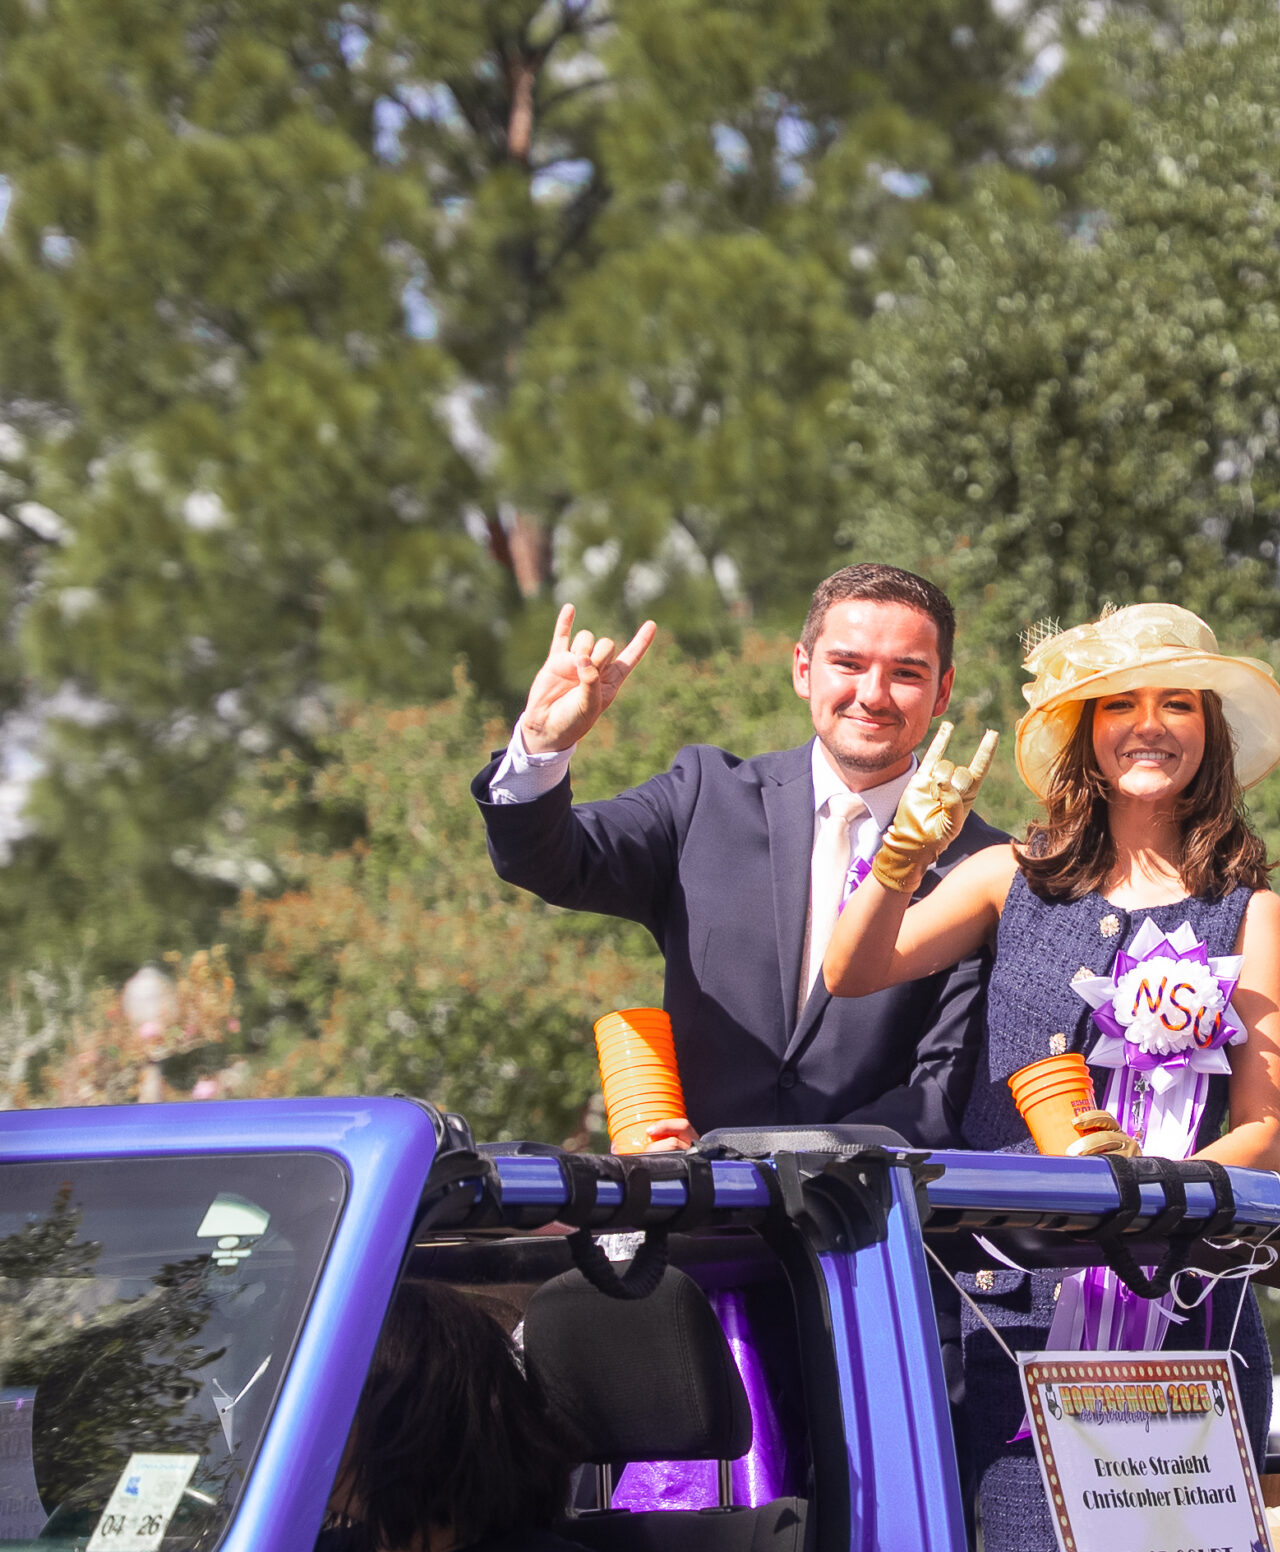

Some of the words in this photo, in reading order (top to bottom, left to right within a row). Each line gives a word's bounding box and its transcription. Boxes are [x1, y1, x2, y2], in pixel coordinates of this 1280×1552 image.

[1131, 975, 1222, 1048] NSU
[1058, 1384, 1168, 1416] HOMECOMING
[1166, 1382, 1212, 1413] 2025
[1094, 1457, 1147, 1477] Brooke
[1149, 1454, 1211, 1476] Straight
[1082, 1488, 1171, 1510] Christopher
[1173, 1485, 1237, 1506] Richard
[101, 1514, 126, 1536] 04
[136, 1514, 162, 1536] 26
